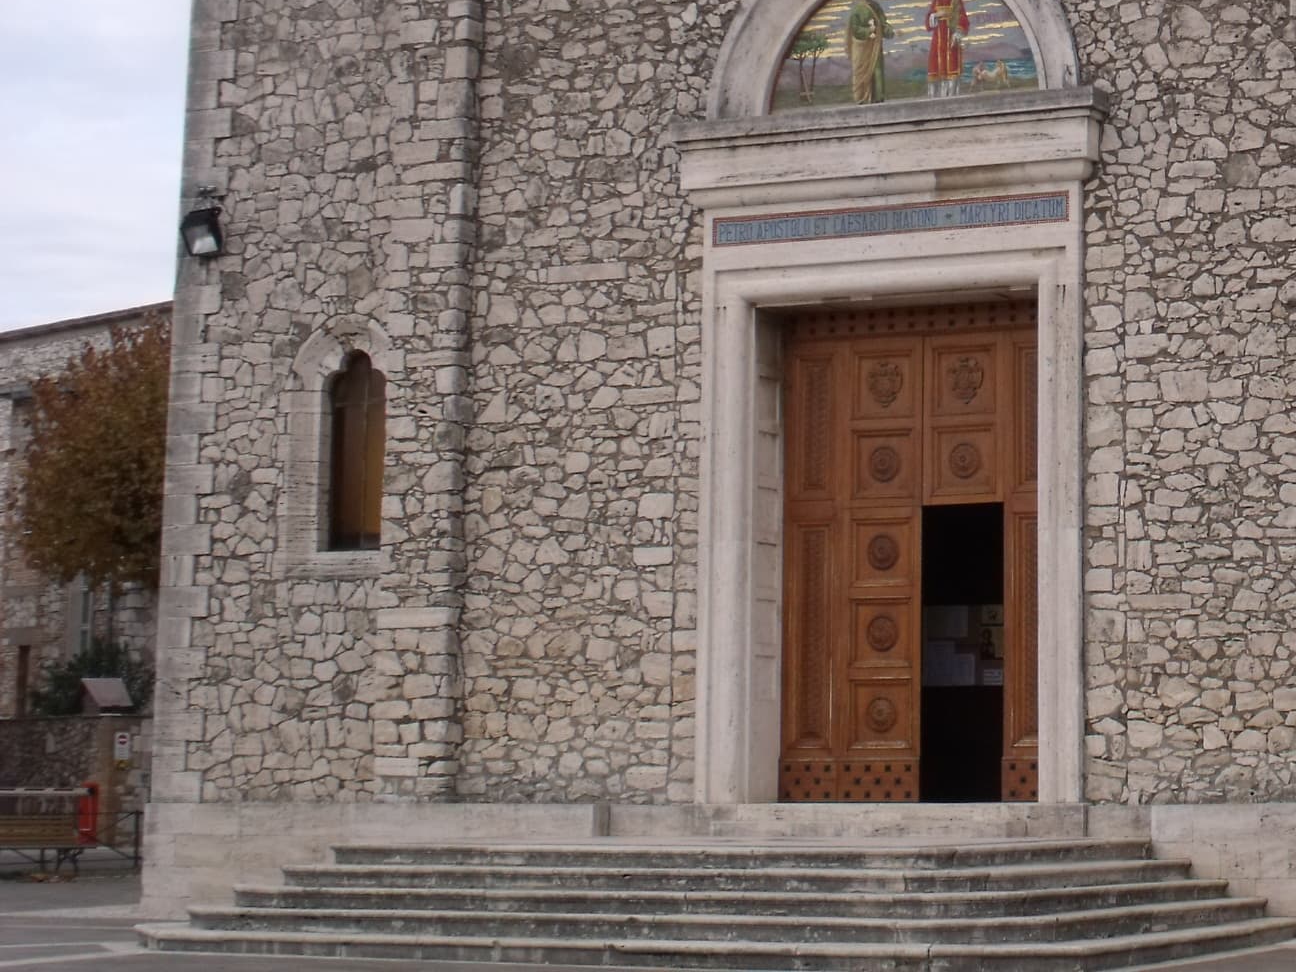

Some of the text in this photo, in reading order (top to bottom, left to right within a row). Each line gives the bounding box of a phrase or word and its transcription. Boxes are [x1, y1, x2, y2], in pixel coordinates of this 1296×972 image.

[718, 222, 754, 243] PETRO
[756, 216, 810, 240] APOSTOLO
[813, 217, 829, 235] ET
[832, 212, 888, 234] CAESARIO
[959, 202, 1010, 224] MARTYRI
[1014, 198, 1065, 220] DICATUM
